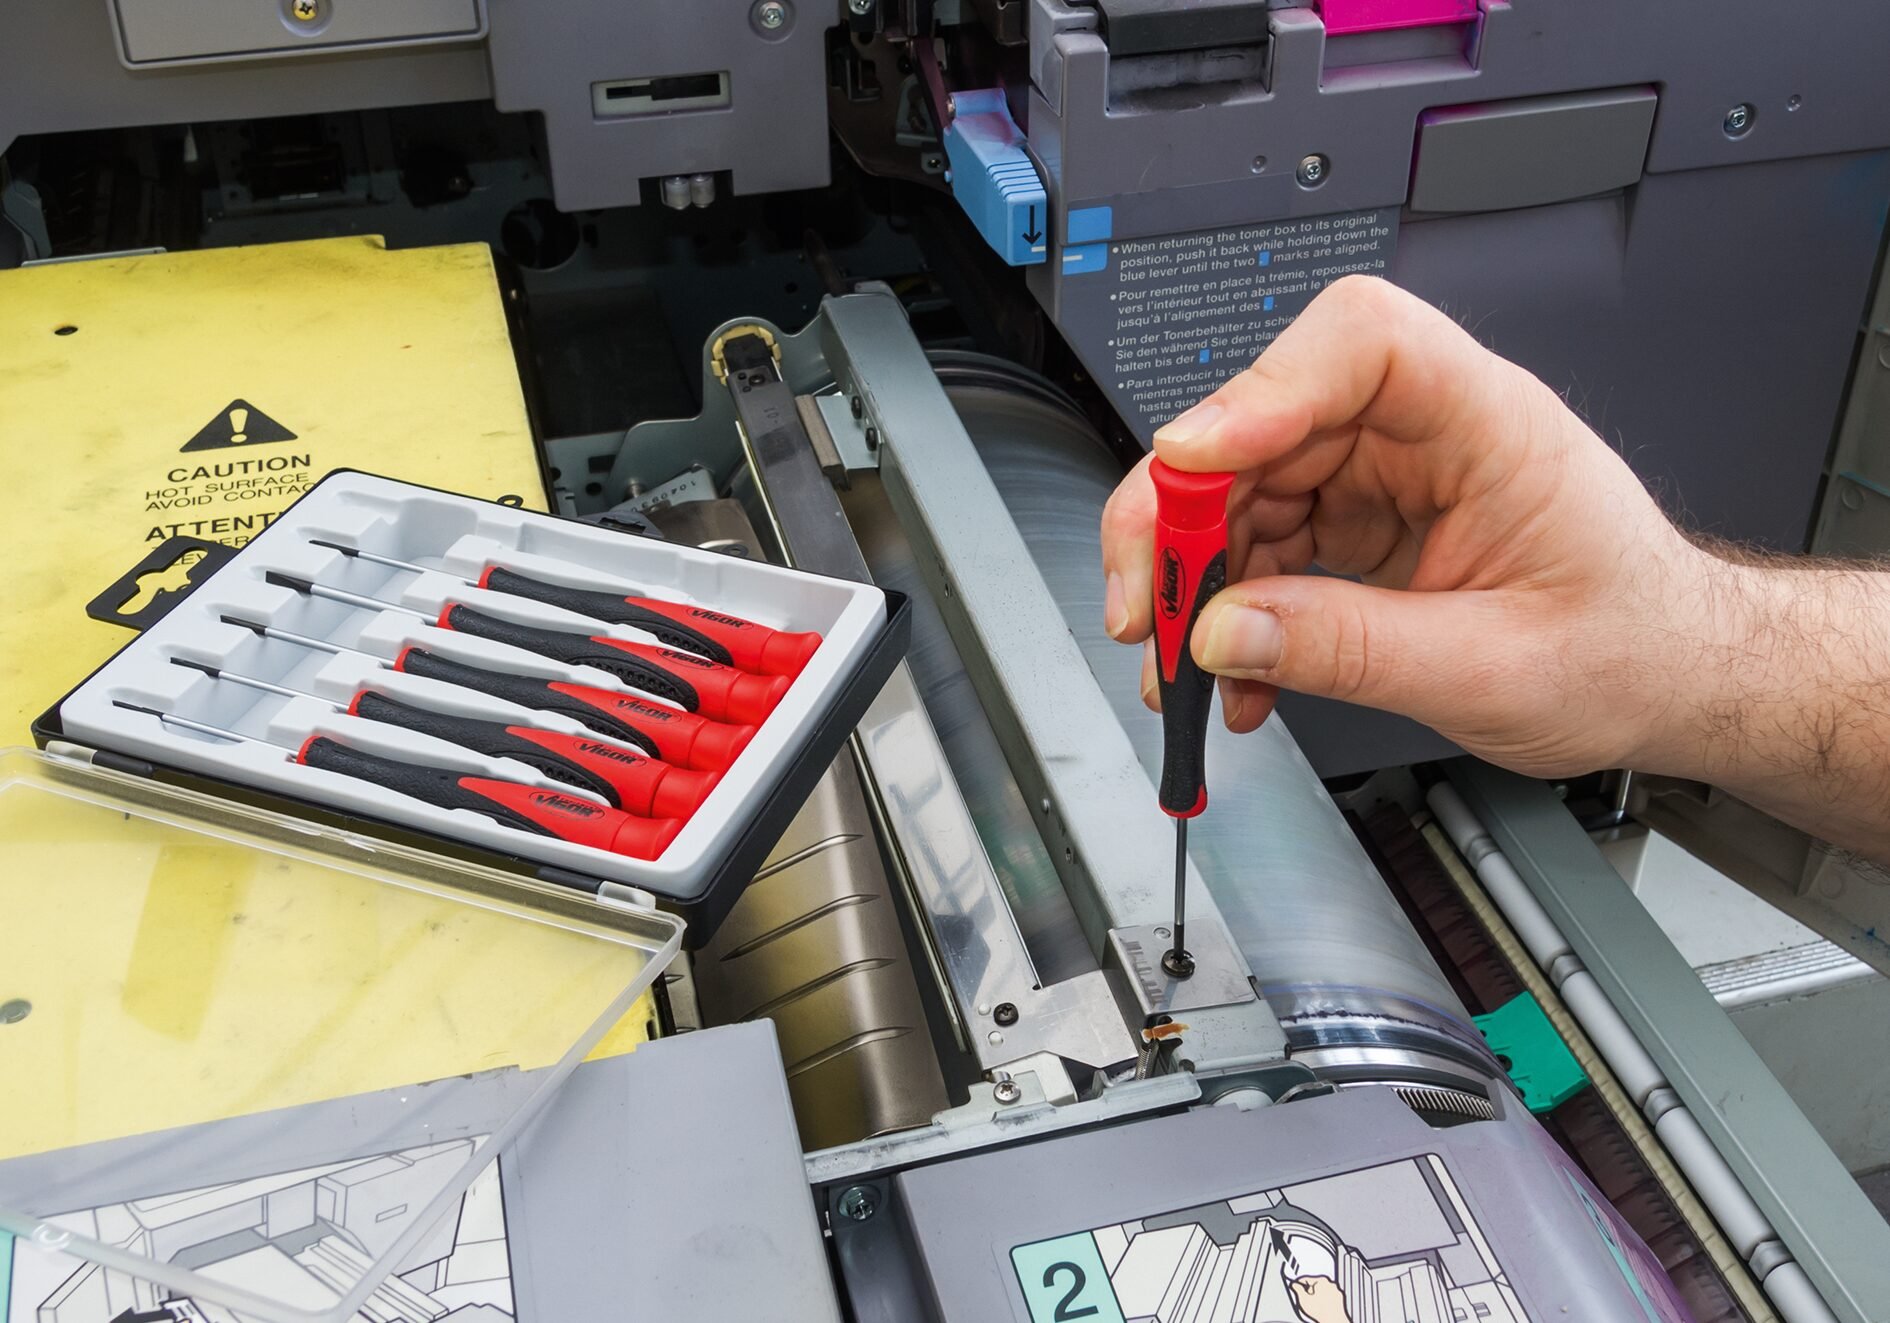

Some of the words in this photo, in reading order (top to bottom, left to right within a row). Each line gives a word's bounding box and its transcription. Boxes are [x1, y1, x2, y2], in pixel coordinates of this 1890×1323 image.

[1121, 243, 1155, 254] When
[1159, 235, 1213, 250] returning
[1217, 232, 1236, 242] the
[1240, 229, 1271, 240] toner
[1274, 226, 1296, 235] box
[1300, 223, 1312, 232] to
[1316, 221, 1330, 230] its
[1333, 214, 1377, 228] original
[1176, 248, 1206, 263] push
[1209, 248, 1217, 257] it
[1221, 243, 1249, 255] back
[1253, 239, 1284, 251] while
[1287, 234, 1331, 247] holding
[1334, 229, 1366, 241] down
[1370, 226, 1389, 236] the
[1120, 271, 1146, 282] blue
[1149, 267, 1178, 278] lever
[1182, 262, 1207, 274] until
[1211, 260, 1230, 270] the
[1234, 257, 1255, 268] two
[1273, 250, 1309, 262] marks
[1313, 247, 1331, 258] are
[1335, 240, 1380, 255] aligned.
[1119, 290, 1147, 301] Pour
[1150, 284, 1199, 297] remettre
[1203, 281, 1217, 291] en
[1220, 276, 1252, 291] place
[1255, 275, 1265, 284] la
[1312, 259, 1385, 277] repoussez-la
[1118, 304, 1143, 315] vers
[1147, 295, 1202, 311] l'intérieur
[1206, 291, 1229, 303] tout
[1233, 290, 1247, 300] en
[1251, 281, 1307, 298] abaissant
[1311, 280, 1320, 289] le
[1116, 336, 1136, 347] Um
[1140, 334, 1160, 344] der
[1163, 323, 1244, 340] Tonerbehälter
[1247, 321, 1261, 330] zu
[1265, 314, 1298, 327] schie
[1117, 314, 1160, 330] jusqu'à
[1164, 304, 1235, 322] l'alignement
[1239, 302, 1260, 312] des
[1115, 360, 1151, 373] halten
[1155, 358, 1172, 368] bis
[1176, 355, 1195, 364] der
[1213, 351, 1223, 360] in
[1226, 347, 1245, 358] der
[1116, 350, 1133, 360] Sie
[1136, 346, 1157, 357] den
[1160, 339, 1208, 354] während
[1211, 337, 1228, 347] Sie
[1231, 333, 1251, 344] den
[1255, 331, 1280, 342] blau
[1127, 379, 1153, 389] Para
[1157, 370, 1212, 385] introducir
[1215, 368, 1225, 377] la
[1133, 387, 1183, 401] mientras
[1139, 401, 1171, 412] hasta
[1174, 398, 1196, 409] que
[1149, 413, 1180, 424] altur
[168, 454, 311, 483] CAUTION
[145, 486, 194, 500] HOT
[205, 472, 309, 493] SURFACE
[145, 495, 212, 512] AVOID
[224, 482, 316, 502] CONTAC
[145, 511, 284, 542] ATTENT
[692, 608, 745, 628] VIGOR
[617, 699, 673, 721] VIGOR
[579, 743, 636, 764] VIGOR
[1043, 1261, 1099, 1323] 2
